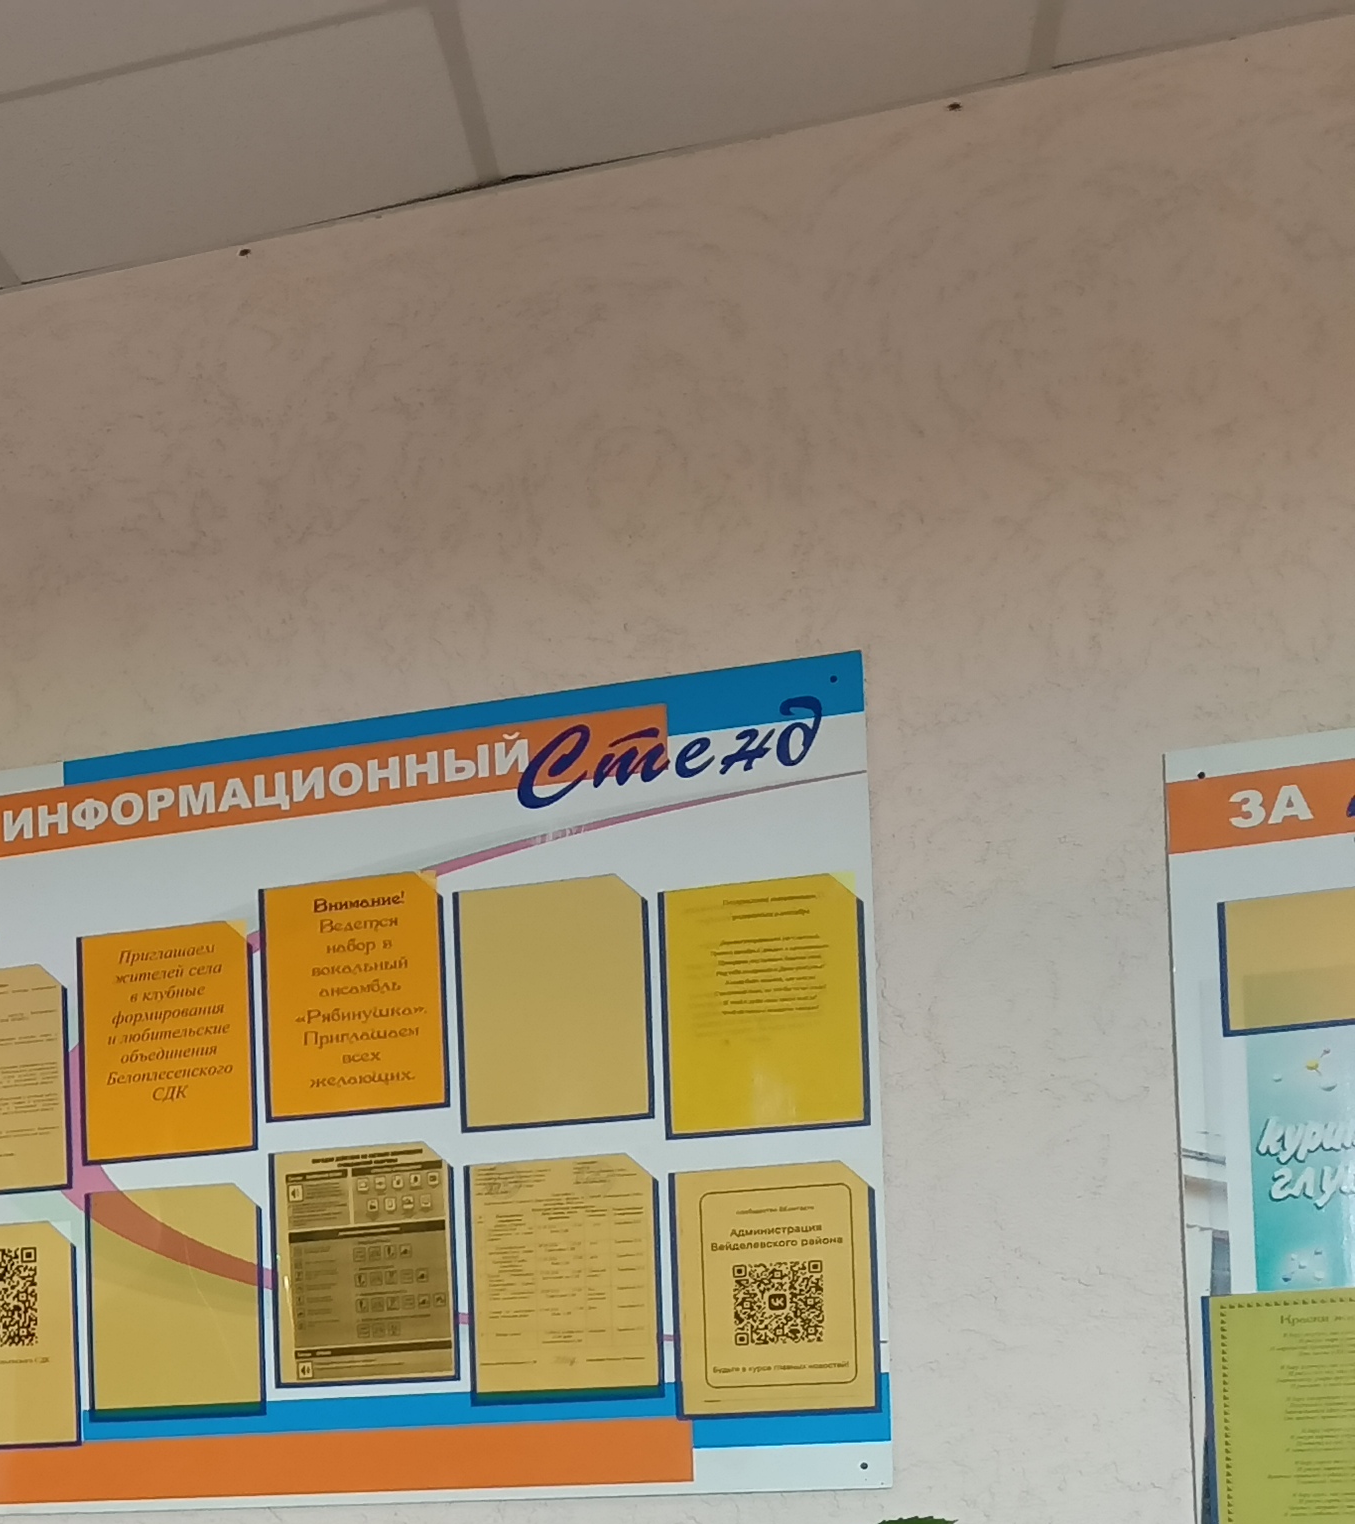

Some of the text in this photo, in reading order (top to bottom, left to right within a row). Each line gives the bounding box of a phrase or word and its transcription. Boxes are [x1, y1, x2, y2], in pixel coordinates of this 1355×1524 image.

[3, 695, 823, 842] ИНФОРМАЦИОННЫЙ Стенд
[1229, 784, 1314, 828] ЗА
[313, 891, 405, 914] Внимание!
[319, 916, 399, 934] Ведется
[118, 944, 215, 966] Приглашаем
[326, 938, 376, 956] набор
[113, 963, 222, 984] жителей села
[311, 956, 409, 977] вокальный
[130, 985, 206, 1003] в клубные
[318, 978, 402, 998] ансамбль
[111, 1003, 225, 1028] формирования
[107, 1023, 231, 1046] и любительские
[303, 1026, 420, 1050] Приглашаем
[120, 1045, 218, 1064] объединения
[342, 1051, 381, 1065] всех
[106, 1064, 234, 1086] Белоплесенского
[309, 1070, 416, 1089] желающих.
[152, 1085, 189, 1103] СДК
[730, 1224, 822, 1238] Администрация
[710, 1236, 843, 1252] Вейделевского района
